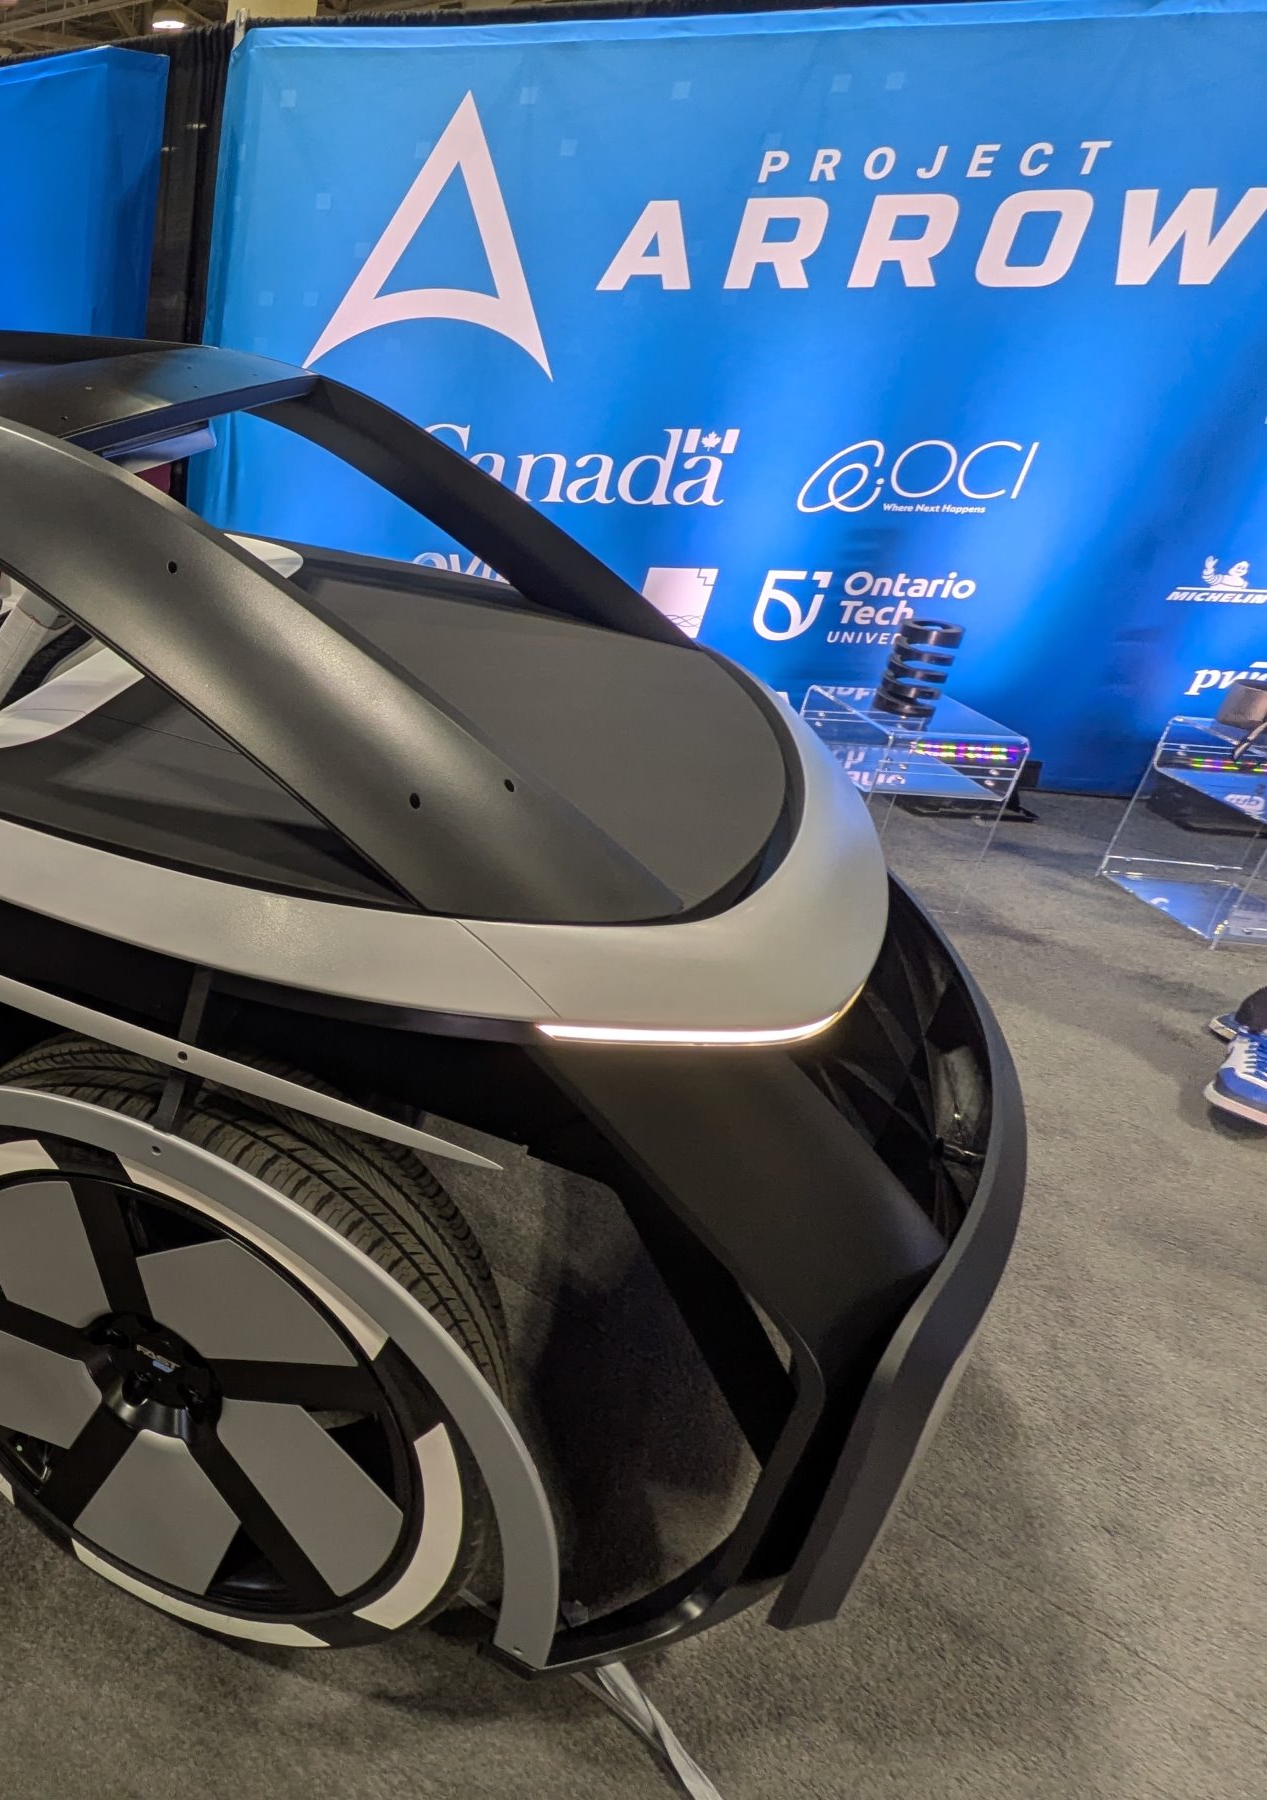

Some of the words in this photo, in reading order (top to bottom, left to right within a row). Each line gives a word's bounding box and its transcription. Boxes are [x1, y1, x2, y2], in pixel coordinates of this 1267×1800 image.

[757, 140, 1113, 183] PROJECT
[595, 187, 1267, 291] ARROW
[890, 439, 1040, 500] OCI
[883, 503, 914, 513] Where
[915, 503, 940, 513] Next
[941, 504, 986, 515] Happens
[844, 571, 978, 600] Ontario
[1165, 591, 1267, 604] MICHELIN
[839, 600, 915, 626] Tech
